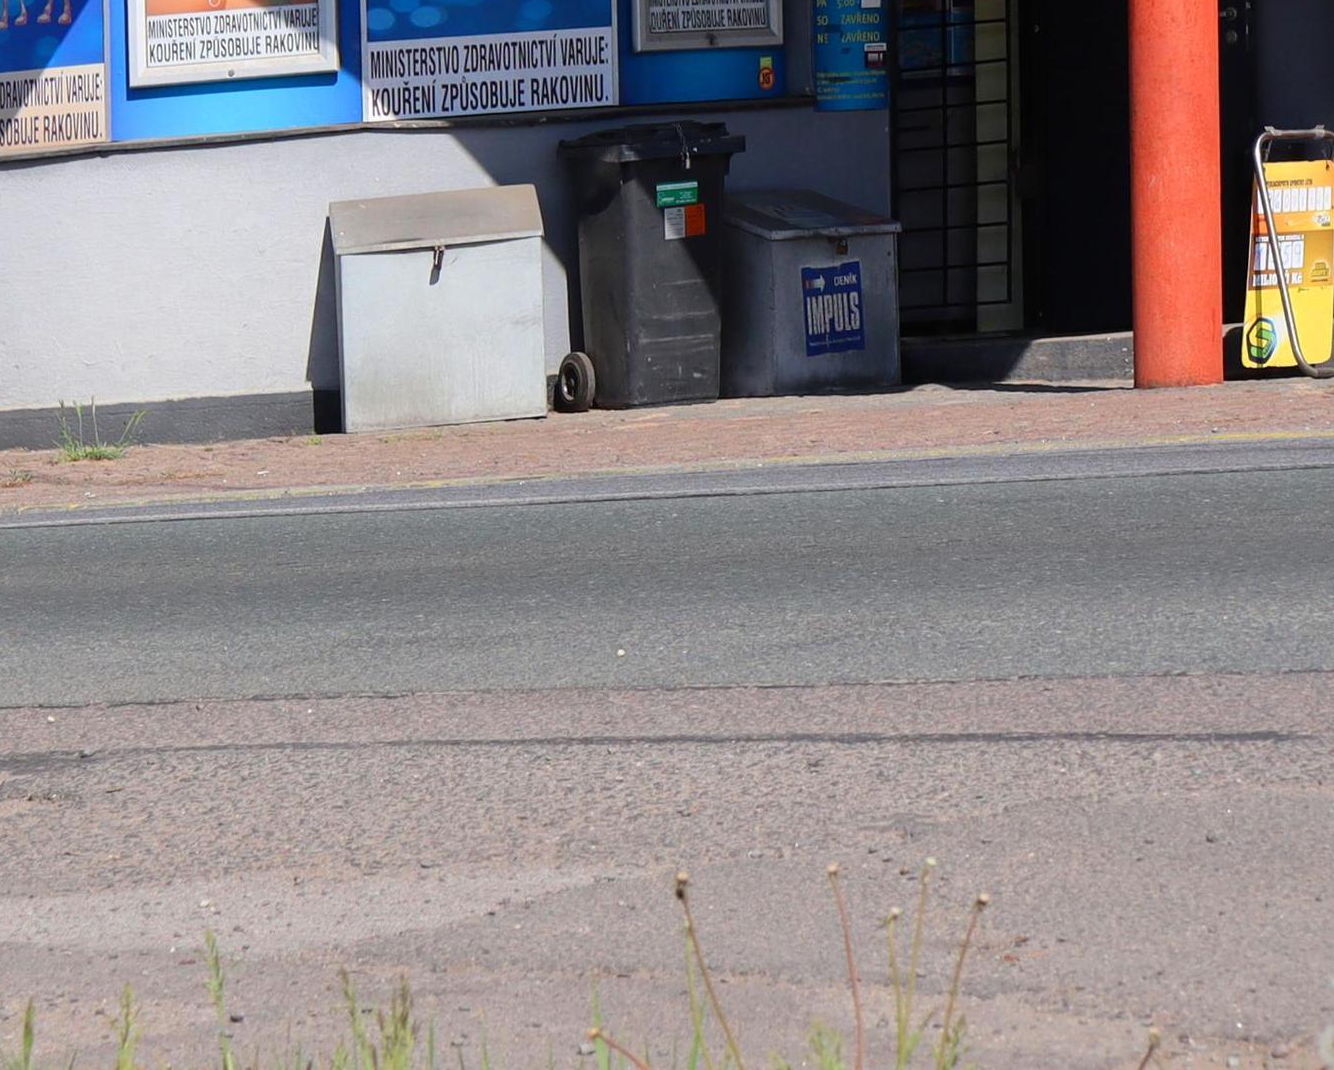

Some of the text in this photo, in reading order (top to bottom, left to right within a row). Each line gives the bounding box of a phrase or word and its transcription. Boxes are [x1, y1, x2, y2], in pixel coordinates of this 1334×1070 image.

[148, 16, 212, 39] MINISTERSTVO
[214, 7, 282, 34] ZDRAVOTNICTVÍ
[682, 8, 726, 29] ZPŮSOBUJE
[841, 11, 880, 25] ZAVŘENO
[149, 37, 197, 64] KOUŘENÍ
[200, 35, 262, 60] ZPŮSOBUJE
[841, 29, 881, 43] ZAVŘENO
[370, 34, 609, 79] MINISTERSTVO ZDRAVOTNICTVÍ VARUJE:
[67, 72, 103, 103] VARUJE:
[372, 73, 610, 117] KOUŘENÍ ZPŮSOBUJE RAKOVINU.
[42, 110, 104, 143] RAKOVINU.
[833, 272, 857, 287] DENÍK
[806, 291, 861, 335] IMPULS
